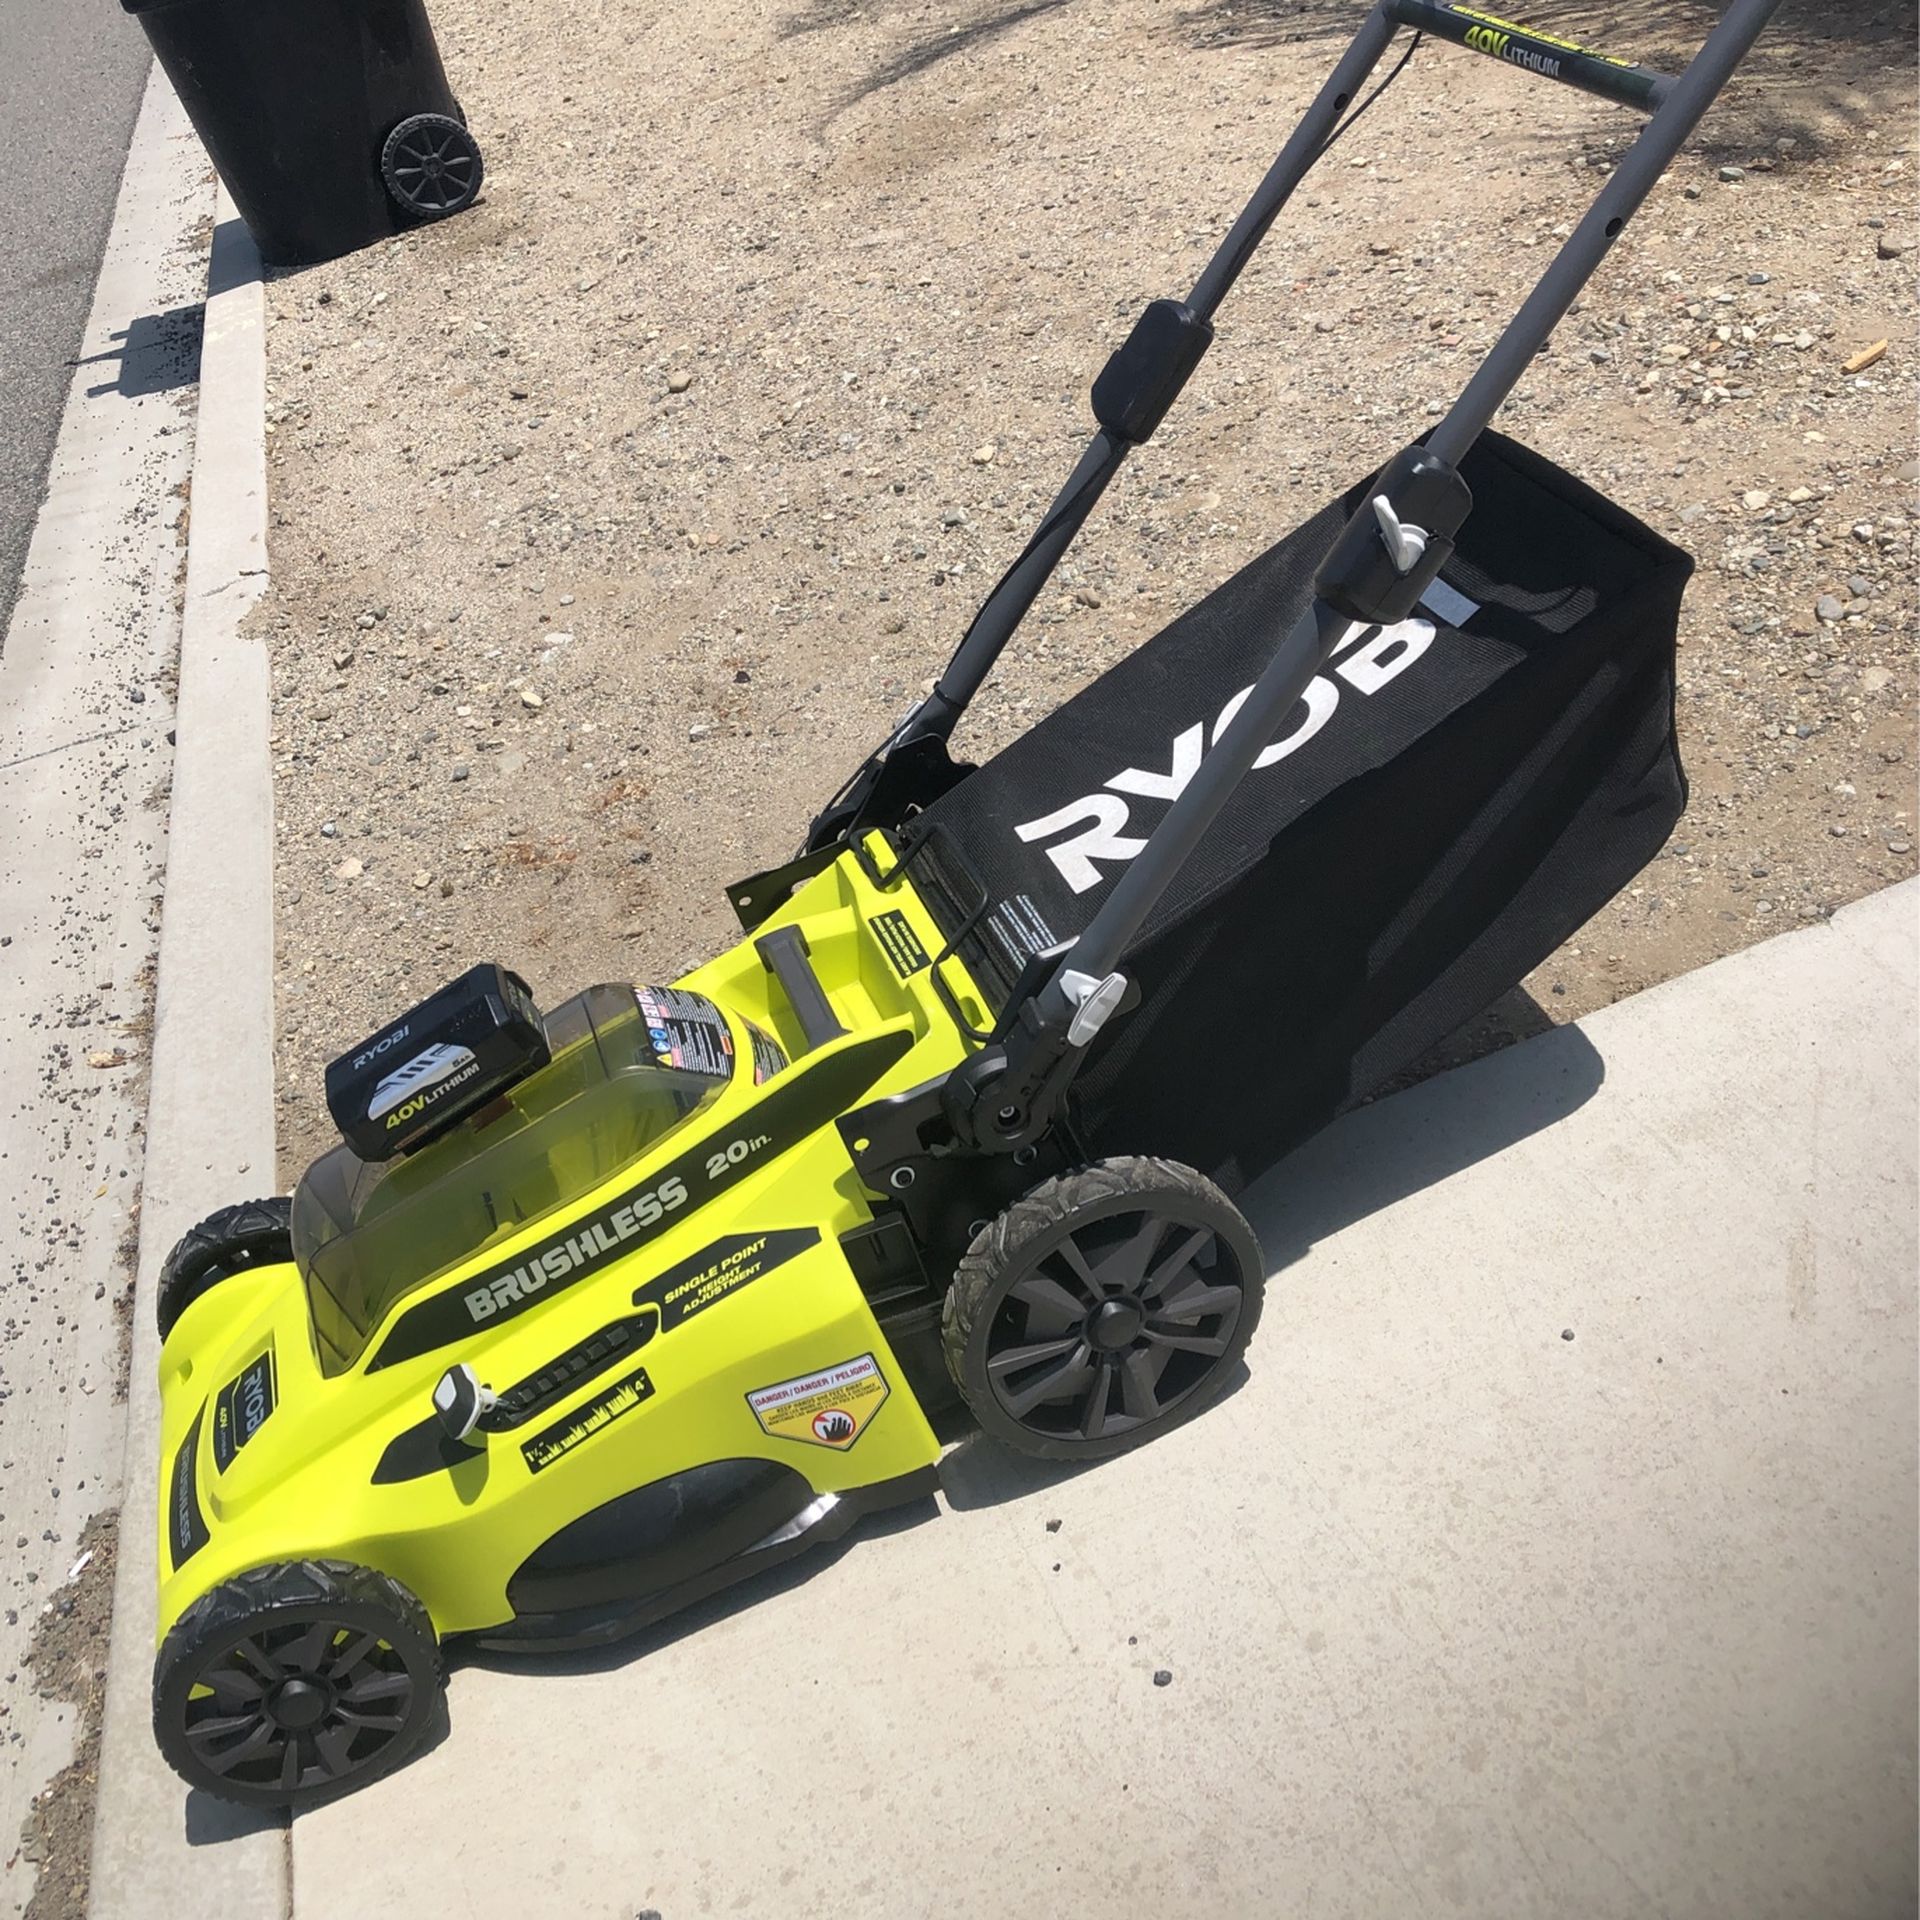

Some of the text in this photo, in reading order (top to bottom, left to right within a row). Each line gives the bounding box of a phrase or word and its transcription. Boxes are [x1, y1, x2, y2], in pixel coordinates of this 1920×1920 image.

[1464, 25, 1509, 56] 40V
[1503, 46, 1561, 77] LITHIUM
[352, 1025, 411, 1070] RYOBI
[385, 1063, 480, 1129] 40V LITHIUM
[463, 1176, 688, 1322] BRUSHLESS
[664, 1237, 768, 1304] SINGLE POINT
[682, 1262, 762, 1314] ADJUSTMENT
[698, 1268, 742, 1297] HEIGHT
[755, 1391, 789, 1406] DANGER
[794, 1378, 830, 1394] DANGER
[835, 1362, 871, 1382] PELIGRO
[179, 1444, 192, 1549] BRUSHLESS
